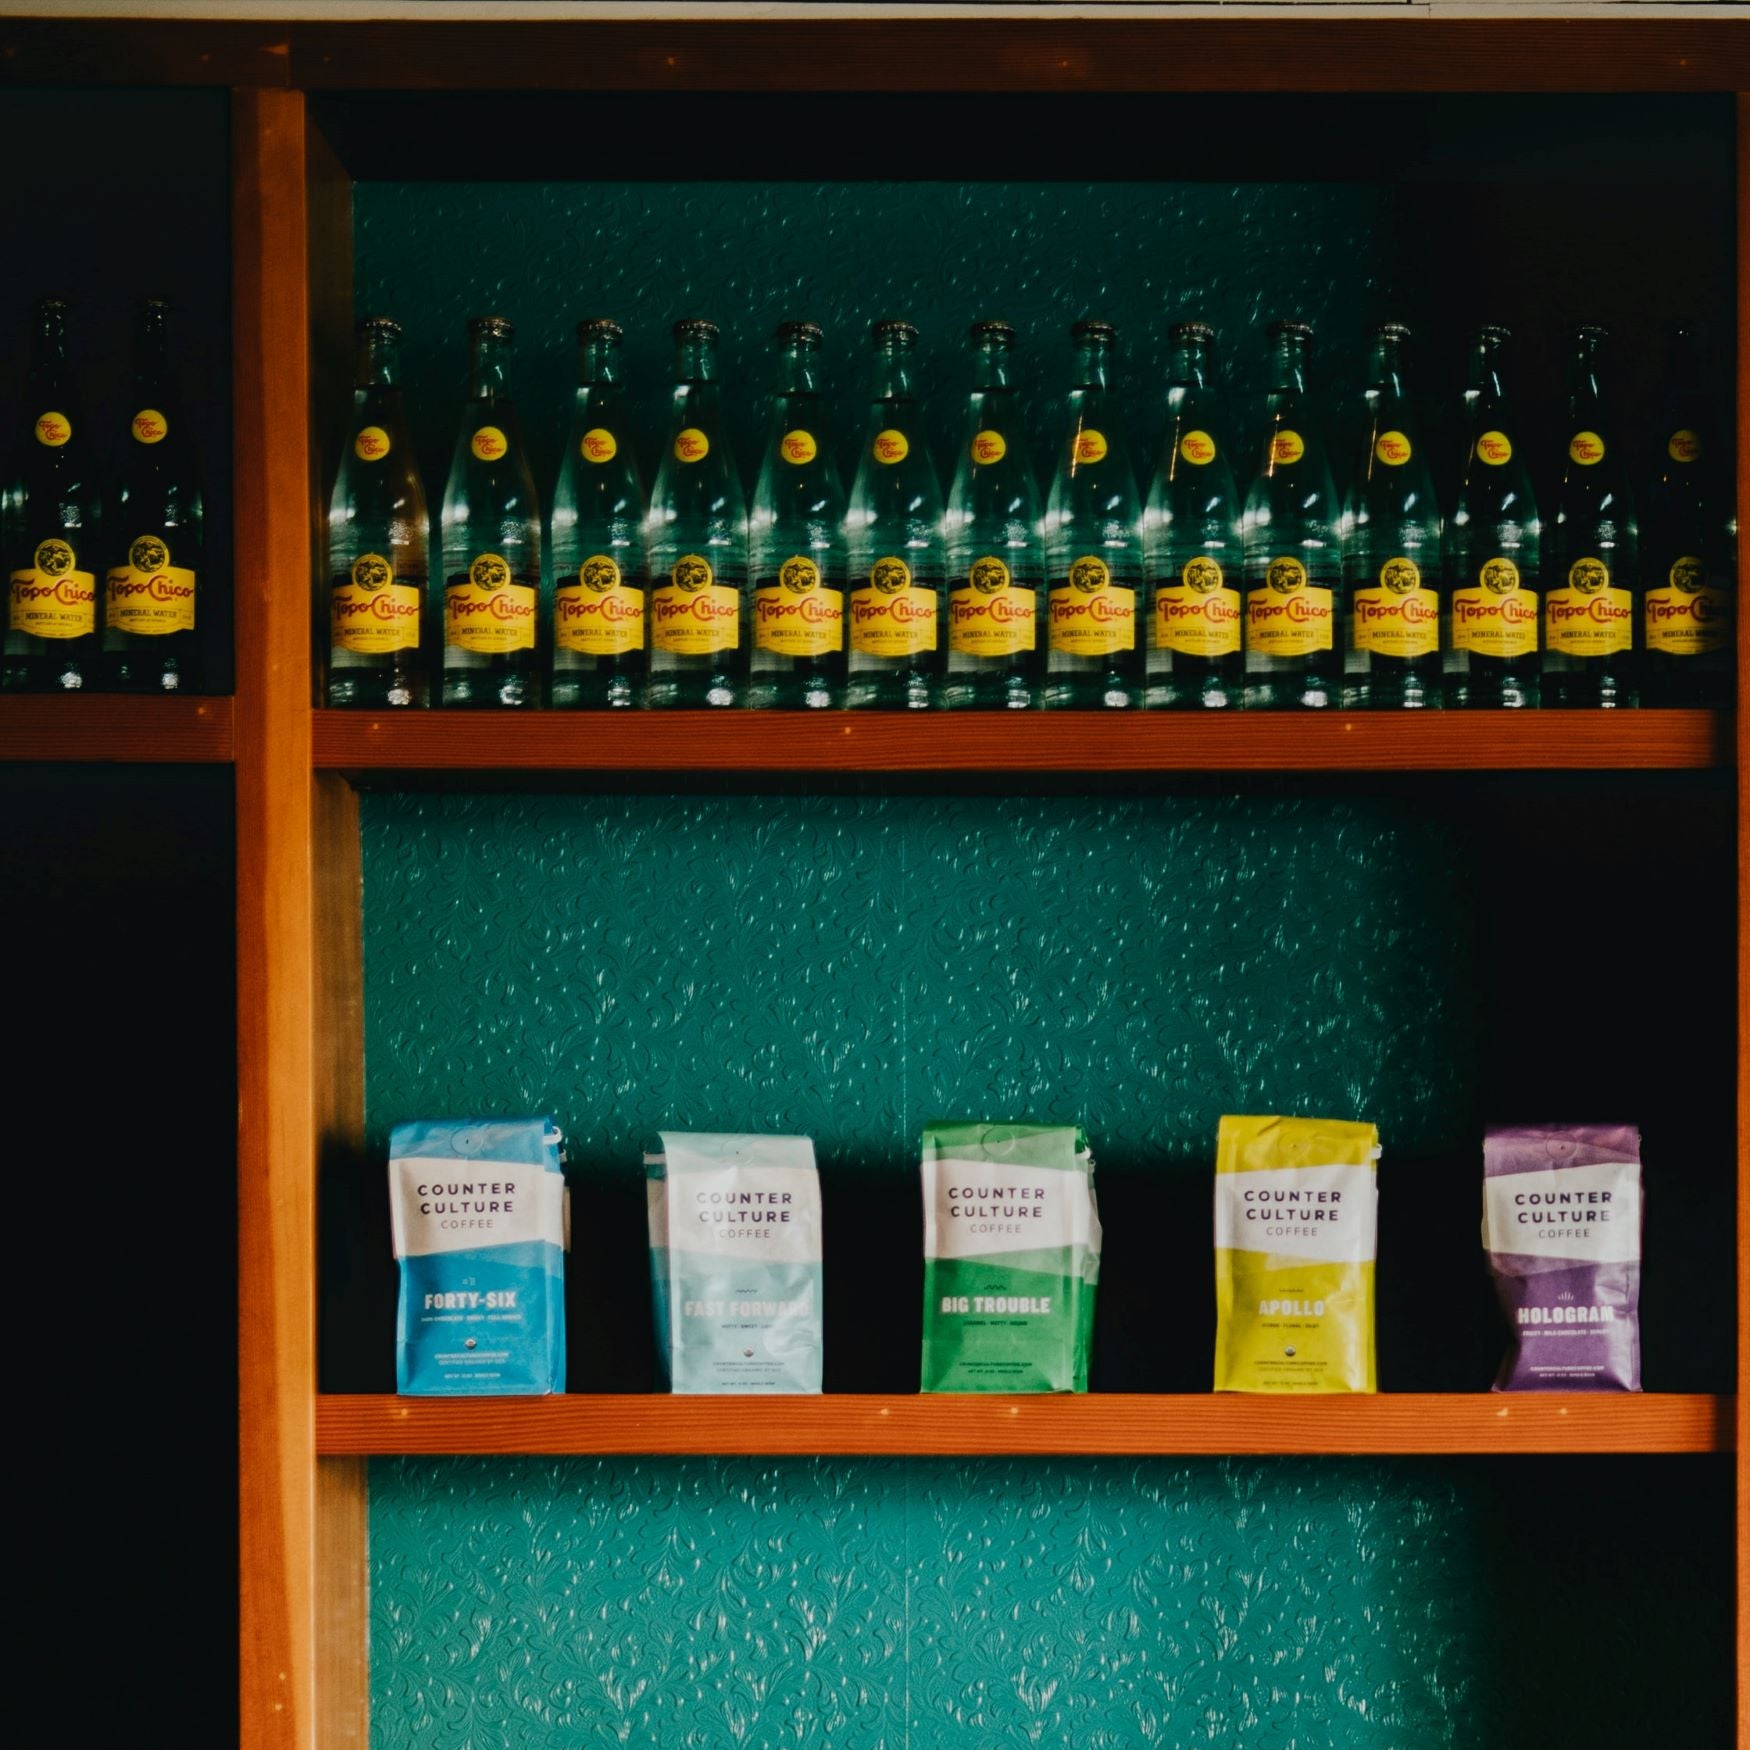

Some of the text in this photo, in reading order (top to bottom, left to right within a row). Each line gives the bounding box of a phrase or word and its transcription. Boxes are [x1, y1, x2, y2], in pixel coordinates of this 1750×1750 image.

[11, 578, 96, 605] Topo Chico
[106, 574, 193, 602] Topo Chico
[334, 594, 418, 620] Topo Chico
[450, 594, 535, 620] Topo Chico
[559, 595, 644, 622] Topo Chico
[654, 595, 738, 623] Topo Chico
[758, 596, 843, 622] Topo Chico
[852, 596, 936, 623] Topo Chico
[951, 596, 1033, 623] Topo Chico
[1051, 596, 1133, 623] Topo Chico
[1158, 596, 1240, 623] Topo Chico
[1250, 596, 1331, 624] Topo Chico
[1356, 598, 1438, 624] Topo Chico
[1455, 597, 1538, 624] Topo Chico
[1547, 596, 1632, 624] Topo Chico
[1648, 598, 1692, 624] Topo
[25, 610, 83, 623] MINERAL WATER
[418, 1182, 516, 1197] COUNTER
[697, 1191, 793, 1205] COUNTER
[948, 1187, 1046, 1201] COUNTER
[1244, 1190, 1342, 1204] COUNTER
[1514, 1191, 1613, 1206] COUNTER
[420, 1200, 514, 1215] CULTURE
[950, 1205, 1043, 1218] CULTURE
[1246, 1208, 1339, 1222] CULTURE
[441, 1218, 494, 1229] COFFEE
[699, 1210, 791, 1224] CULTURE
[1518, 1210, 1611, 1224] CULTURE
[719, 1229, 771, 1239] COFFEE
[969, 1223, 1022, 1234] COFFEE
[1266, 1226, 1318, 1238] COFFEE
[1538, 1228, 1591, 1240] COFFEE
[425, 1290, 517, 1310] FORTY-SIX
[685, 1300, 726, 1318] FAST
[941, 1296, 1051, 1314] BIG TROUBLE
[1259, 1299, 1325, 1317] APOLLO
[1518, 1305, 1614, 1324] HOLOGRAM
